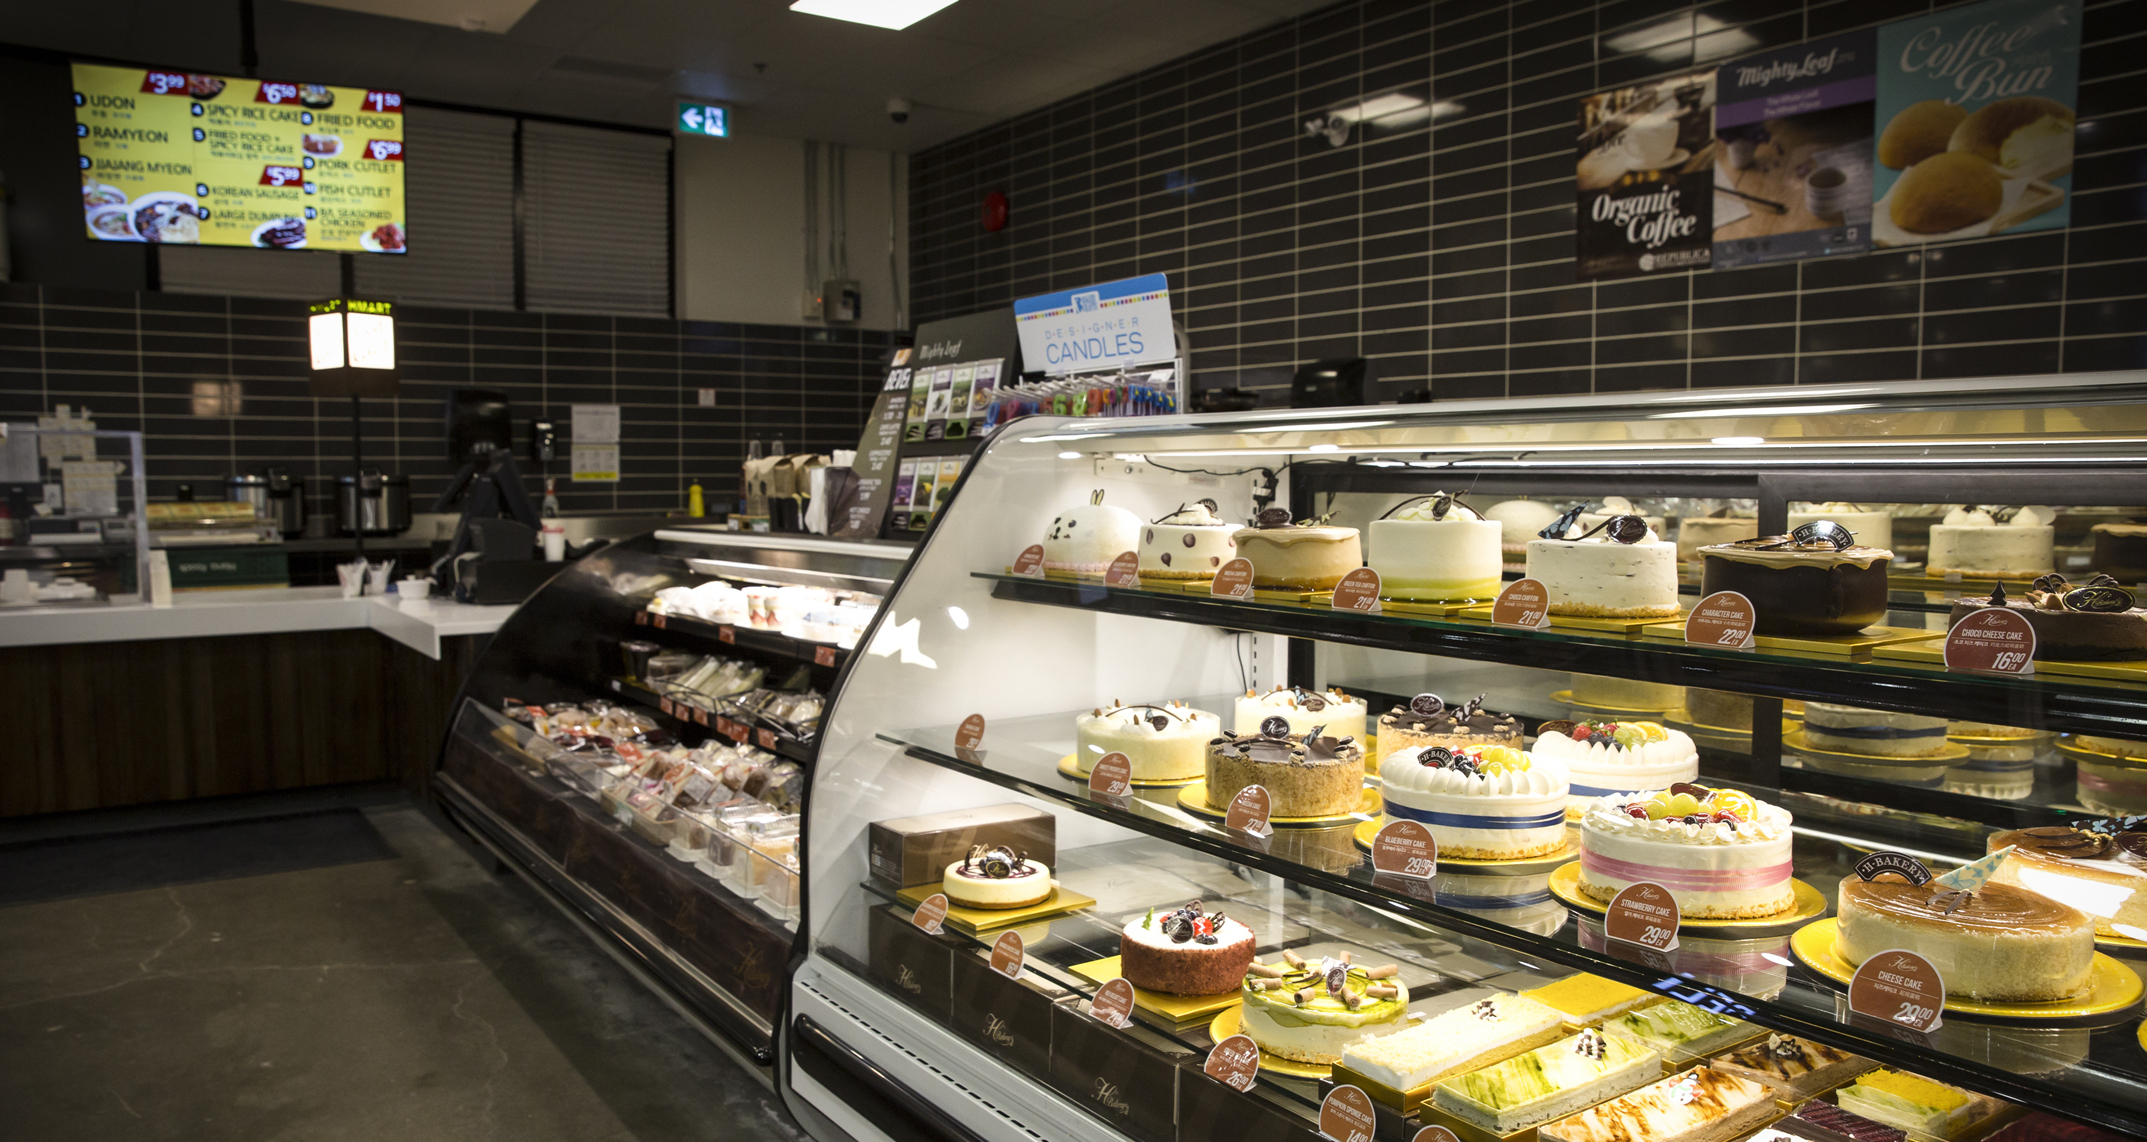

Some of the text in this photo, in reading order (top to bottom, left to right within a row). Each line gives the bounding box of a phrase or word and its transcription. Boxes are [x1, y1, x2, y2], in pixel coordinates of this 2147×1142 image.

[1900, 21, 2031, 80] Coffee
[1736, 60, 1799, 88] Mighty
[1795, 46, 1837, 77] Leaf
[1945, 57, 2053, 106] Bun
[90, 95, 135, 109] UDON
[207, 105, 239, 118] SPICY
[242, 107, 265, 120] RICE
[269, 109, 299, 122] CAKE
[317, 113, 353, 127] FRIED
[356, 116, 396, 130] FOOD
[93, 126, 168, 143] RAMYEON
[318, 160, 349, 171] PORK
[353, 161, 397, 174] CUTLET
[347, 186, 392, 198] CUTLET
[1592, 184, 1681, 228] Organic
[1626, 215, 1697, 249] Coffee
[1046, 331, 1144, 365] CANDLES
[1702, 609, 1744, 620] CHARACTER CAKE
[1962, 628, 2023, 641] CHOCO CHEESE CAKE
[1385, 836, 1426, 848] BLUEBERRY CAKE
[1621, 899, 1671, 917] STRAWBERRY CAKE
[1878, 970, 1923, 990] CHEESE CAKE
[1913, 1019, 1923, 1027] EA
